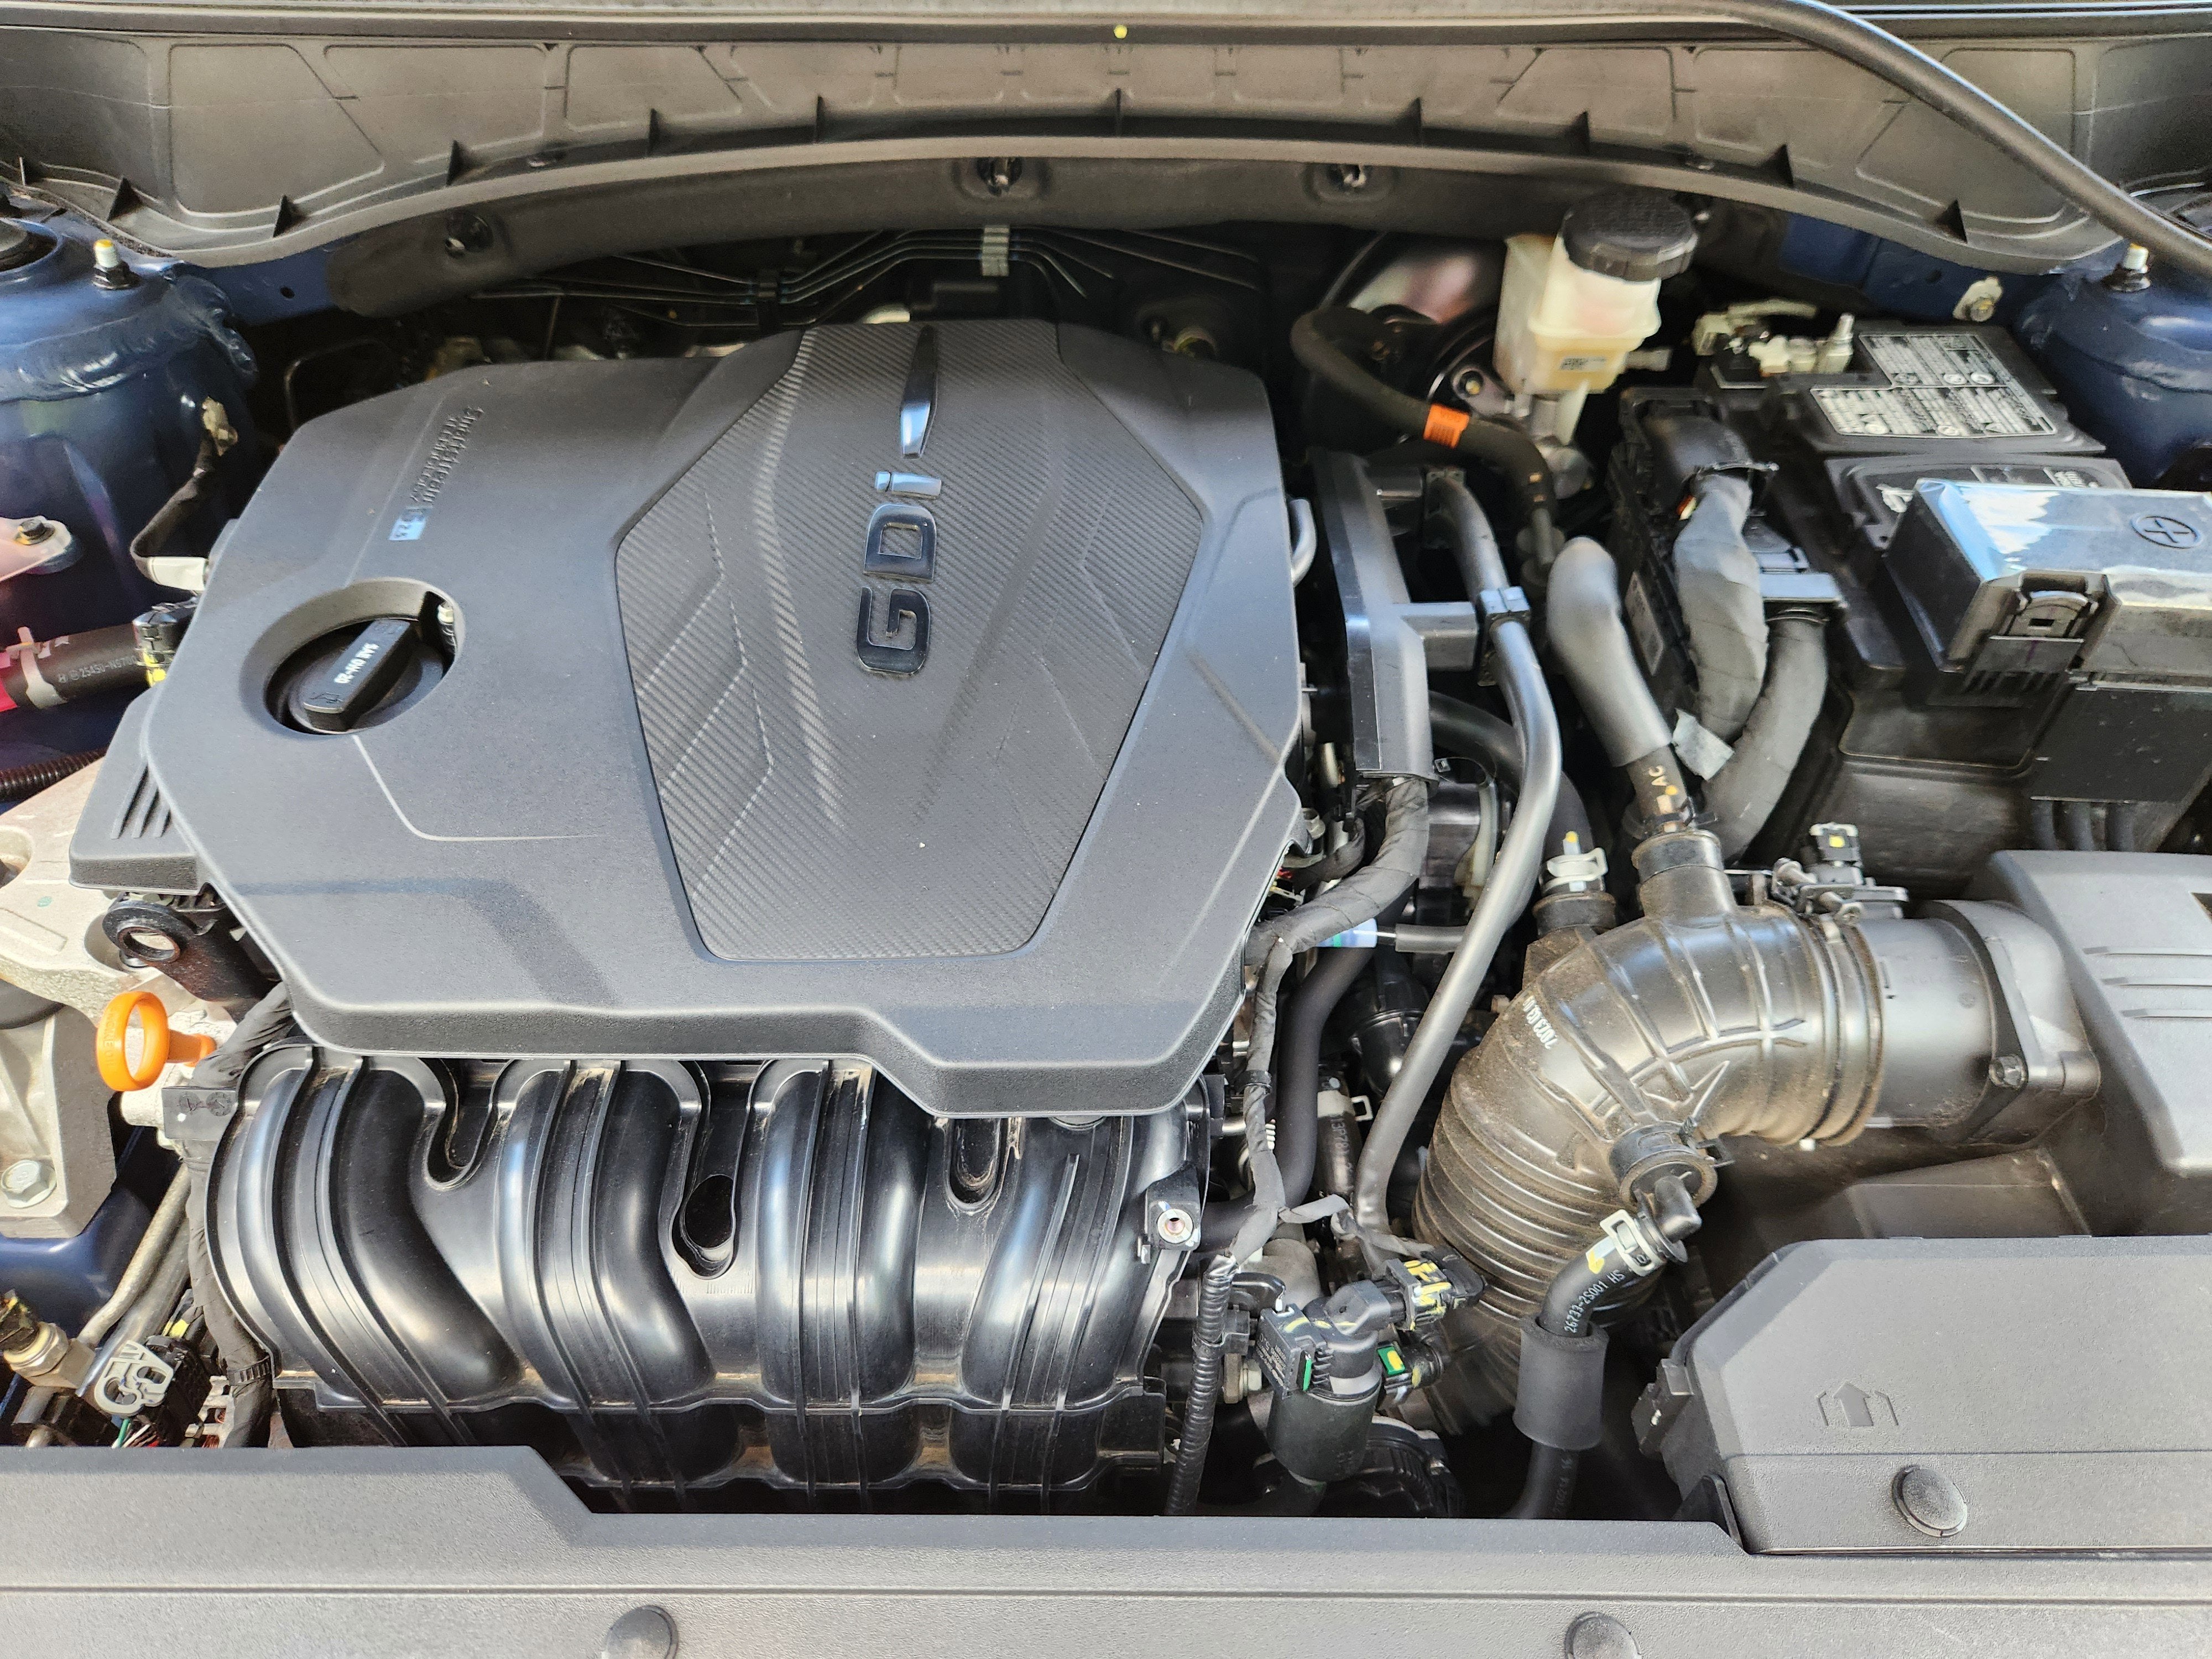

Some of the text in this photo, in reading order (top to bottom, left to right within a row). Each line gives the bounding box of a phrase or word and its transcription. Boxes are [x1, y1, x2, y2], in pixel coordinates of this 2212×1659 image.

[857, 471, 941, 676] GDi
[356, 642, 380, 659] SAE
[1648, 765, 1667, 786] AC
[1611, 1269, 1626, 1284] HS
